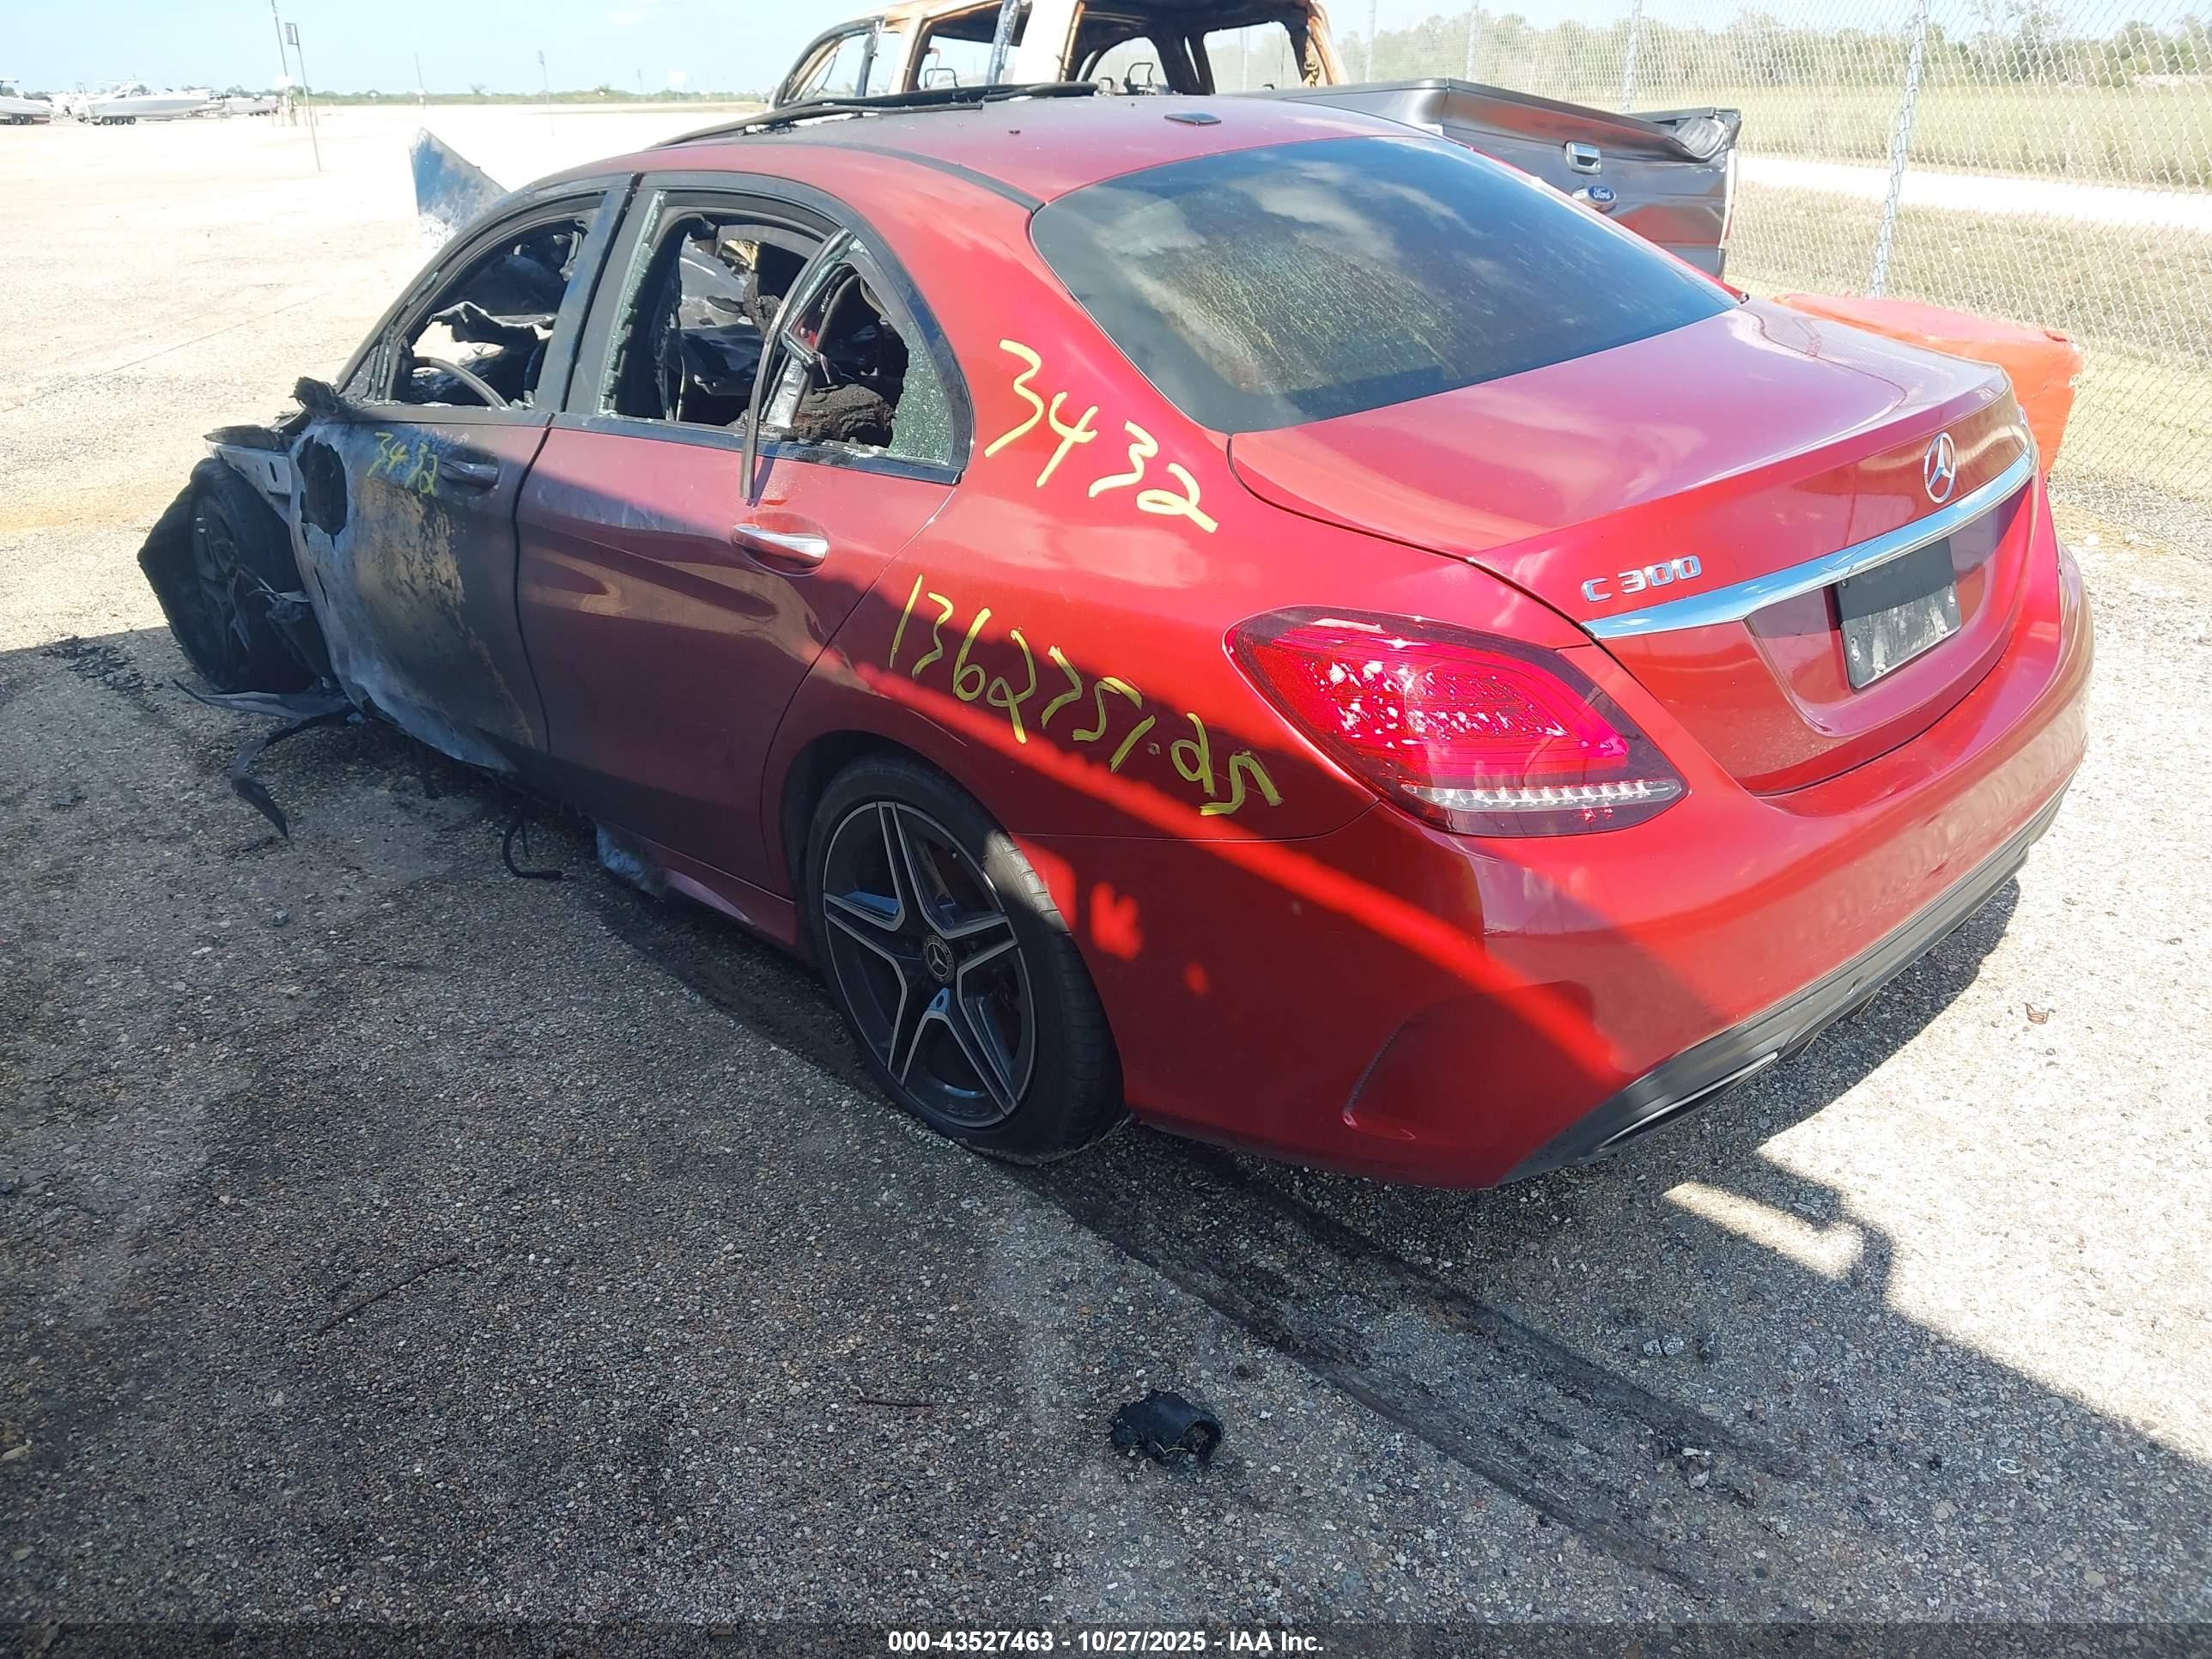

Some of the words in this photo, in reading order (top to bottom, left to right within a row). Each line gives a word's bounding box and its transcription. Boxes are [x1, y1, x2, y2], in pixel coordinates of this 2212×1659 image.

[367, 431, 439, 496] 3432
[984, 338, 1219, 533] 3432
[1581, 577, 1613, 603] C
[1617, 555, 1703, 594] 300
